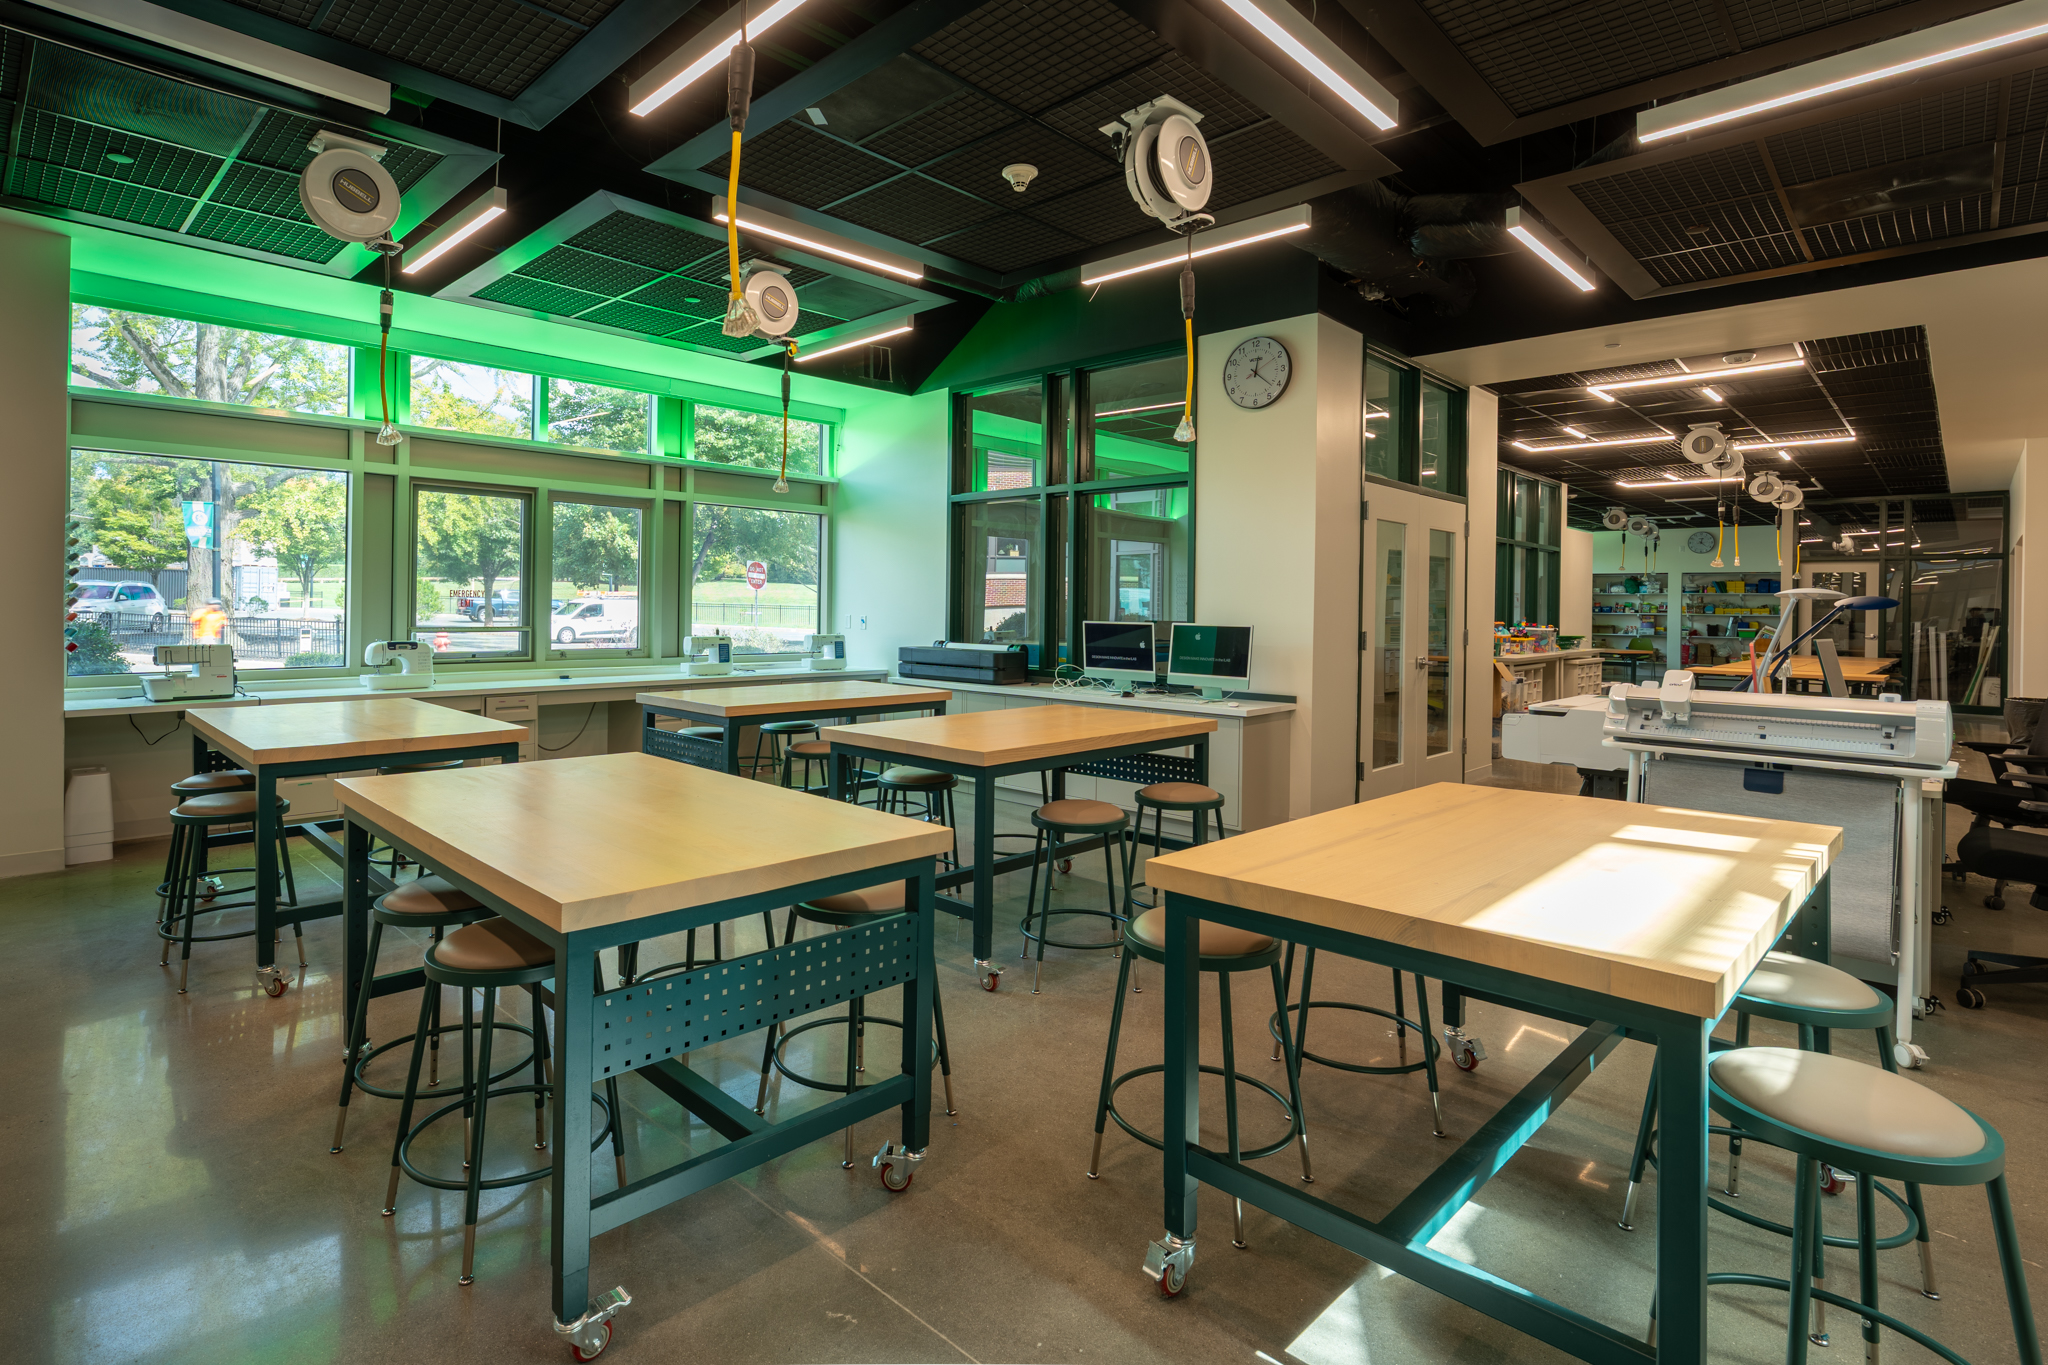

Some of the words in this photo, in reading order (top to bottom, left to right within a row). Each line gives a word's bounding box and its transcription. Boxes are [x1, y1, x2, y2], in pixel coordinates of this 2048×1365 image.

[1188, 148, 1198, 175] HUBBELL
[340, 178, 372, 204] HUBBELL
[766, 295, 785, 310] HUBBELL
[460, 599, 474, 607] EXIT
